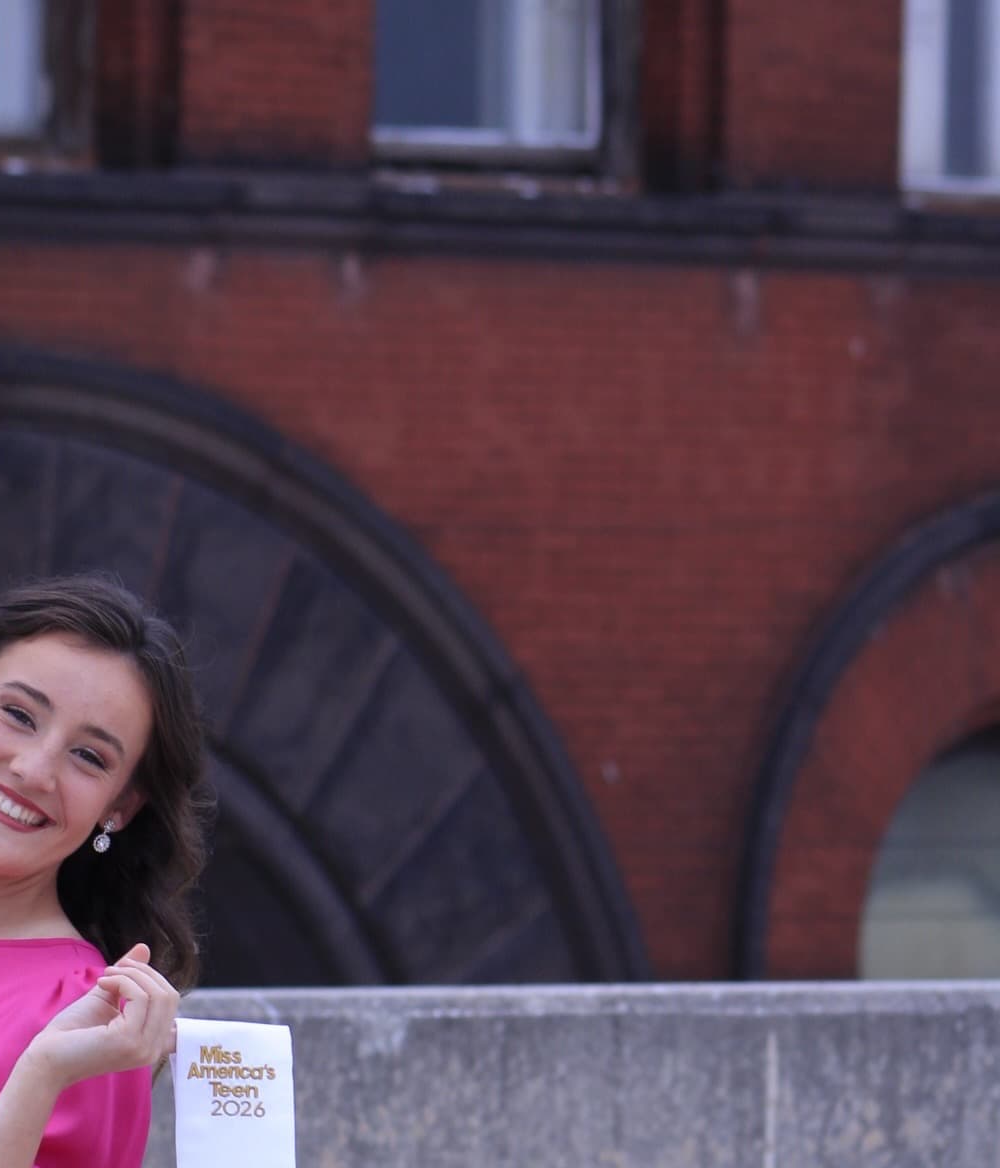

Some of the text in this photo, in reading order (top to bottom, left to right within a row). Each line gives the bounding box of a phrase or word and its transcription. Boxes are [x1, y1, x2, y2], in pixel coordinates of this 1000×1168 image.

[199, 1044, 242, 1064] Miss
[187, 1062, 277, 1081] America's
[208, 1080, 259, 1099] Teen
[210, 1099, 266, 1118] 2026
